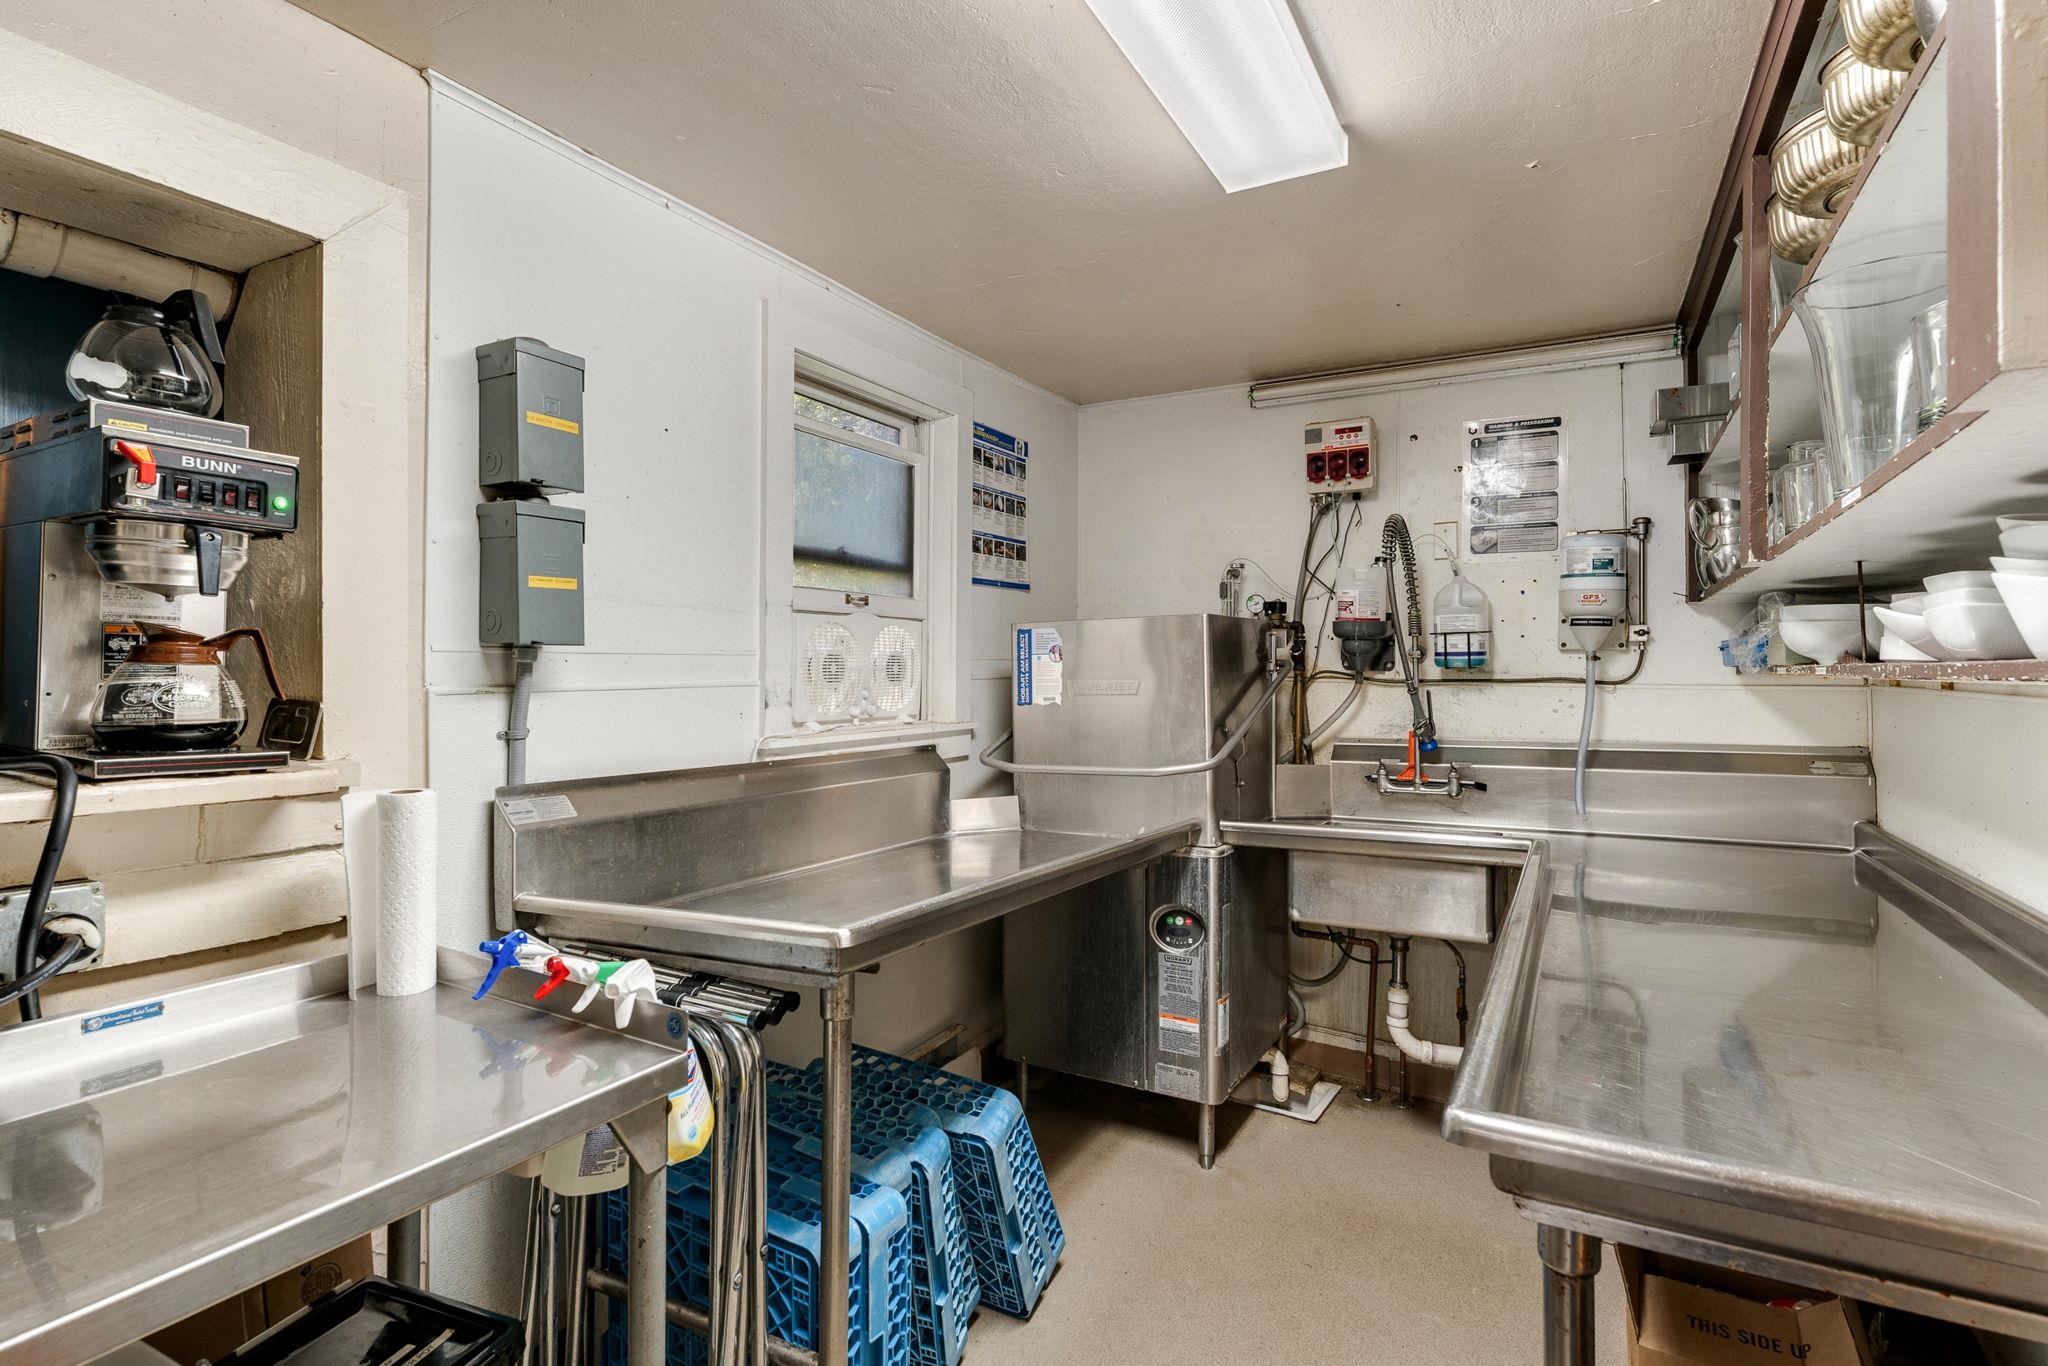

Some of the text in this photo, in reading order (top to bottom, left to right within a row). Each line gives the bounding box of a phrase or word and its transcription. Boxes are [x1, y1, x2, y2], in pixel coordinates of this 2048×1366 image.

[117, 421, 146, 430] CAUTION
[182, 455, 237, 474] BUNN
[1686, 1314, 1812, 1360] THIS SIDE UP
